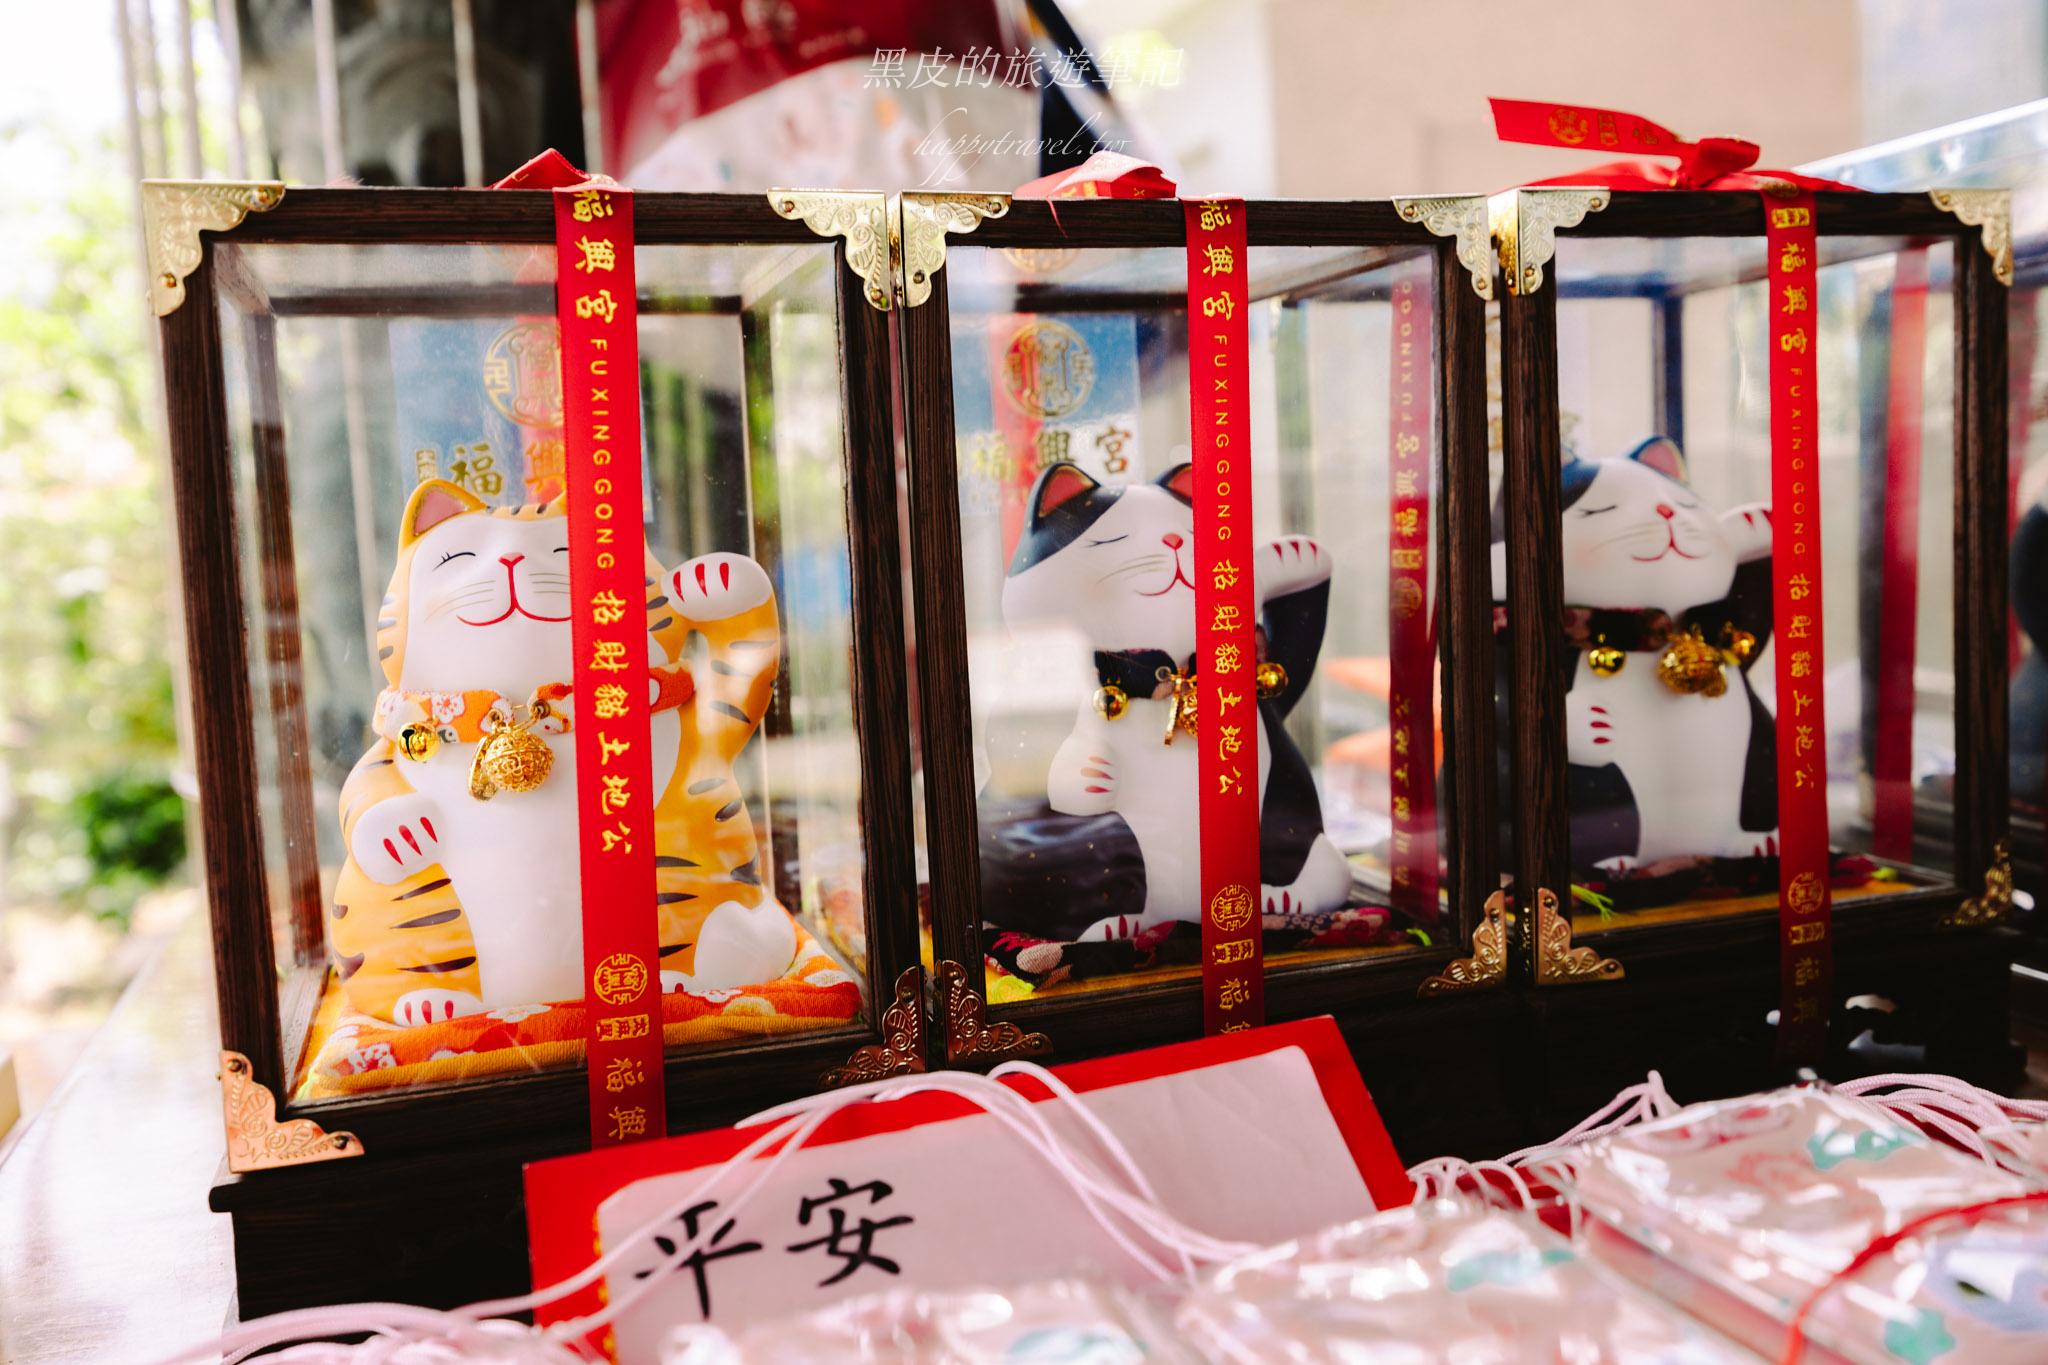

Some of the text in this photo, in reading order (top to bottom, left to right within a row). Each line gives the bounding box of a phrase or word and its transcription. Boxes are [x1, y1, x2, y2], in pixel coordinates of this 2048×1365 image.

[572, 190, 619, 323] 福興宮
[1199, 199, 1236, 320] 福興宮
[588, 588, 633, 854] 招財貓土地公
[1210, 558, 1243, 796] 招財貓土地公
[633, 1177, 915, 1322] 平安
